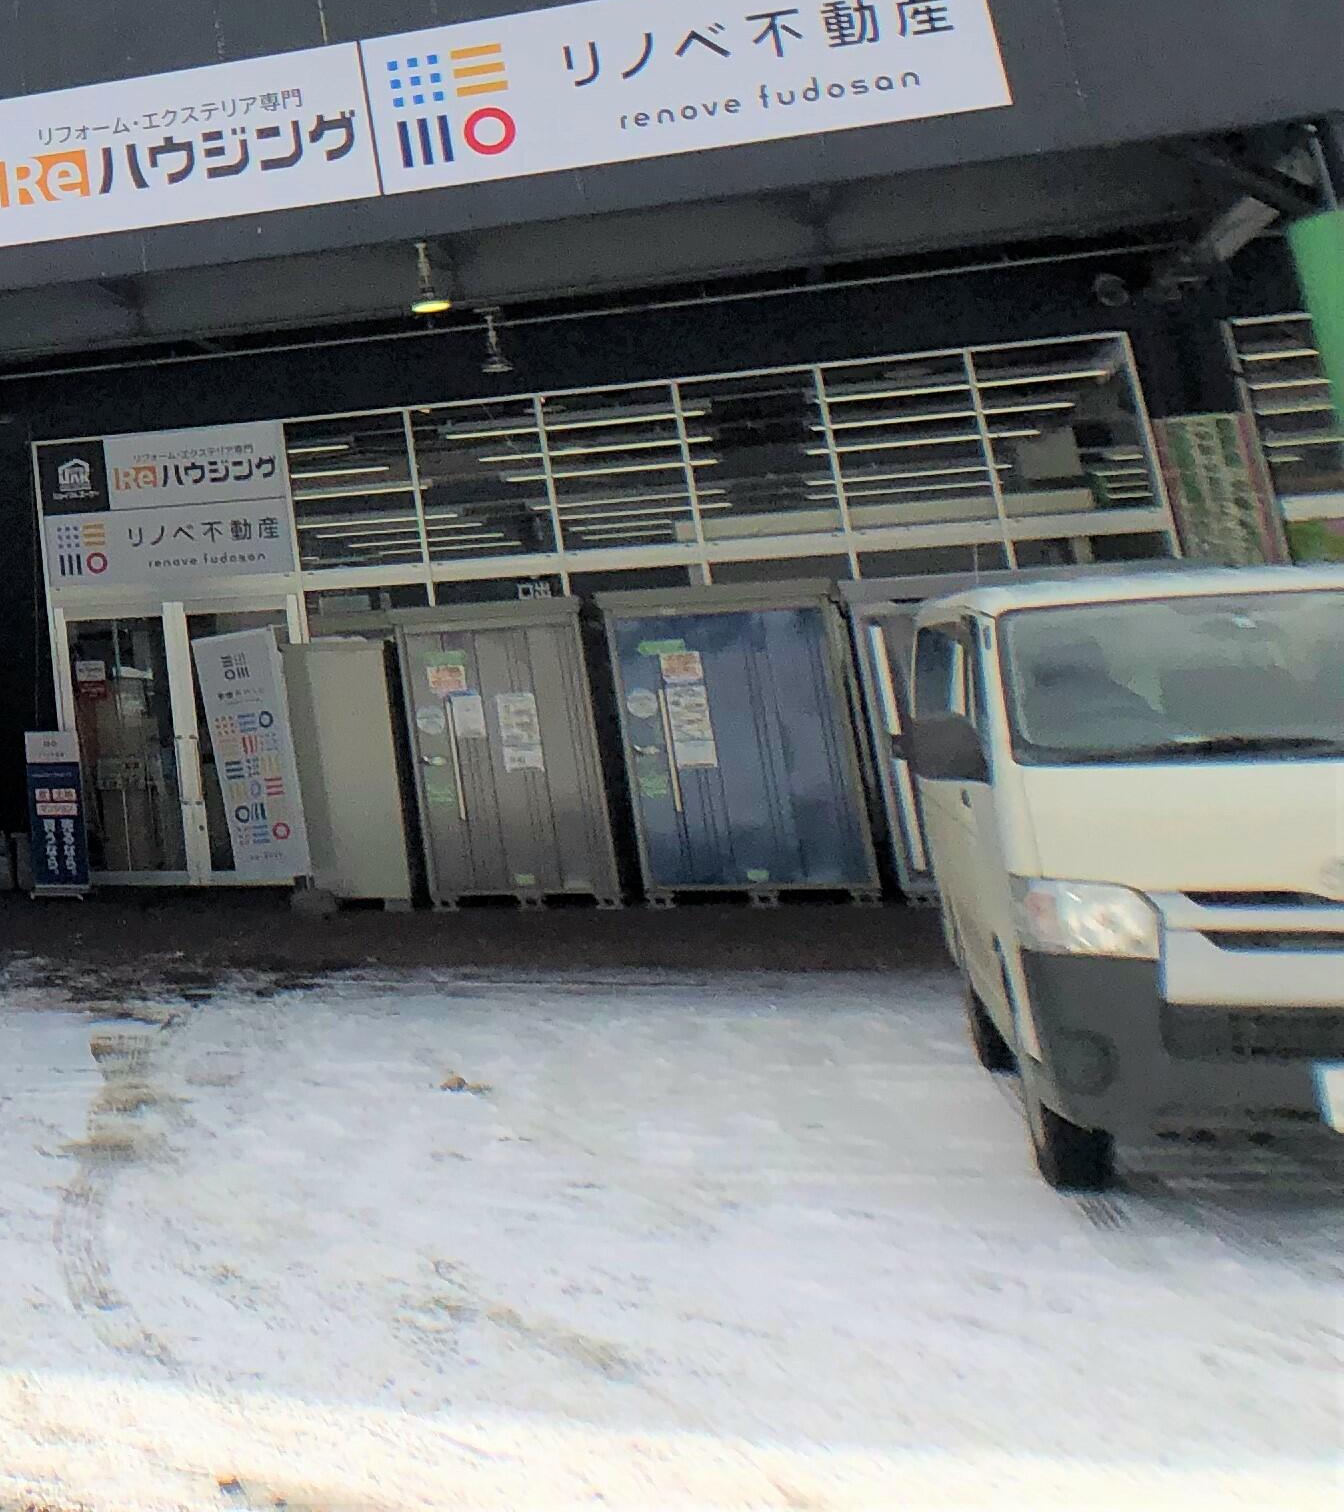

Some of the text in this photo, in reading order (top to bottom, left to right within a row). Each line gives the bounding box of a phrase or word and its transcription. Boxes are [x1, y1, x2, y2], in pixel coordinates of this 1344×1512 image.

[38, 88, 303, 146] リフォーム・エクステリア専門
[620, 70, 922, 130] renove fudosan
[127, 516, 280, 548] リノベ不動産
